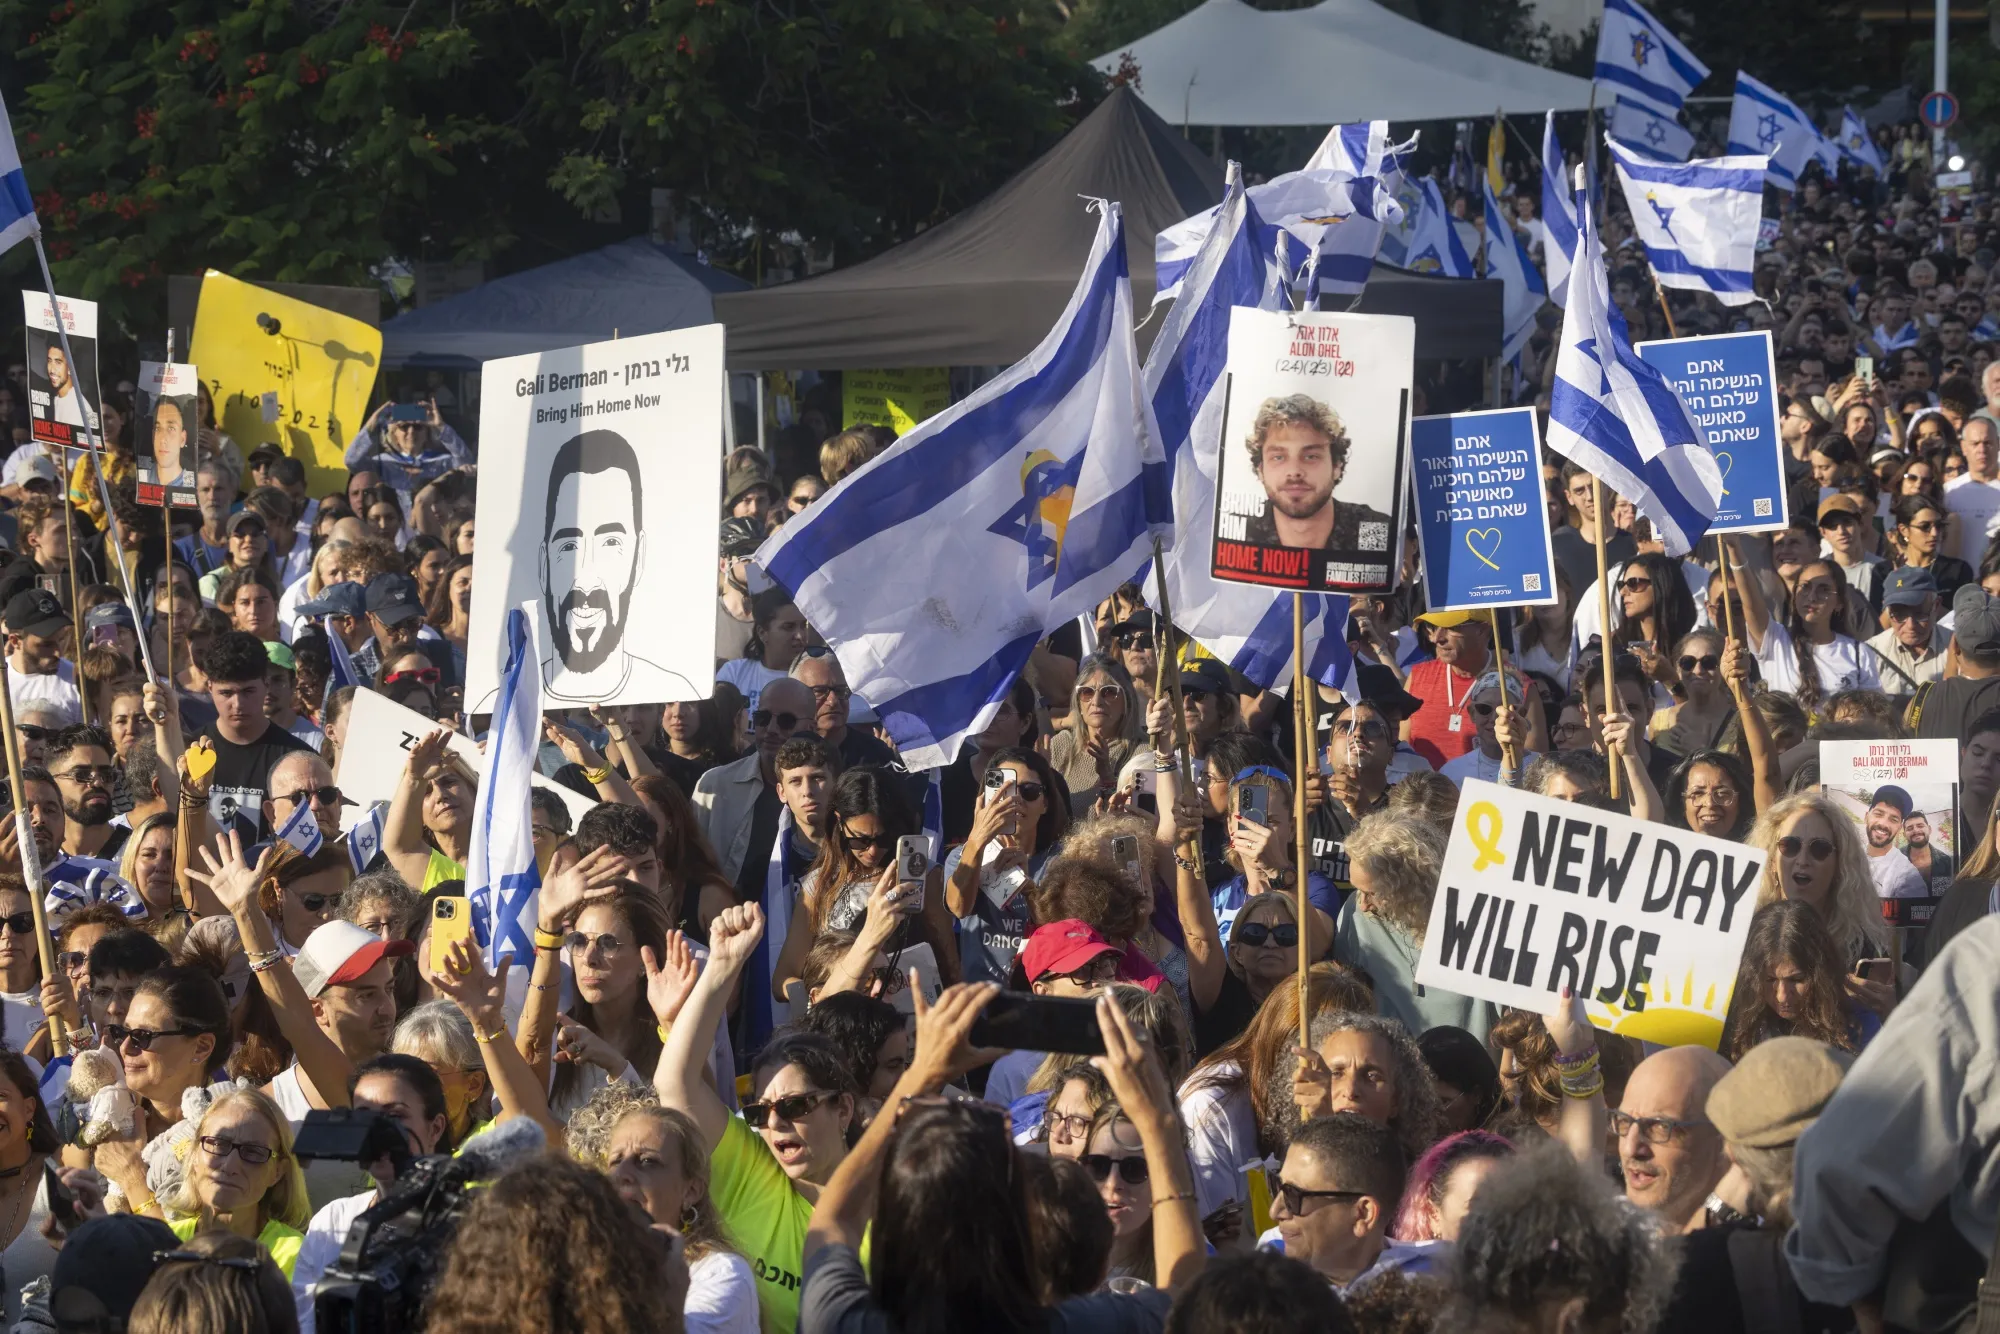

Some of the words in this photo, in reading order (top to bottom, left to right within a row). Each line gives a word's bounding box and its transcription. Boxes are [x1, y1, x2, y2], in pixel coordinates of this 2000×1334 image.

[1318, 326, 1339, 342] אלון
[1289, 342, 1315, 357] ALON
[1318, 343, 1342, 359] OHEL
[665, 353, 690, 373] גלי
[1687, 359, 1724, 374] אתם
[624, 360, 660, 386] ברמן
[516, 375, 544, 397] Gali
[549, 368, 607, 392] Berman
[1700, 374, 1762, 391] הנשימה
[31, 389, 50, 406] BRING
[1710, 391, 1759, 408] שלהם
[536, 408, 567, 424] Bring
[570, 403, 594, 418] Him
[597, 398, 631, 415] Home
[634, 393, 661, 408] Now
[1693, 410, 1745, 426] מאושר
[34, 419, 52, 435] HOME
[52, 423, 71, 439] NOW!
[1709, 427, 1759, 444] שאתם
[1455, 435, 1491, 450] אתם
[1422, 455, 1463, 470] והאור
[1468, 449, 1528, 467] הנשימה
[1429, 472, 1474, 490] חיכינו,
[1478, 466, 1525, 484] שלהם
[1445, 486, 1513, 504] מאושרים
[1220, 492, 1266, 517] BRING
[1477, 503, 1527, 519] שאתם
[1436, 508, 1473, 523] בבית
[1218, 511, 1247, 541] HIM
[1216, 541, 1259, 571] HOME
[1262, 548, 1310, 577] NOW!
[1326, 561, 1354, 571] HOSTAGES
[1354, 563, 1365, 572] AND
[1326, 570, 1359, 584] FAMILIES
[1360, 572, 1387, 584] FORUM
[1182, 662, 1202, 673] M
[1869, 745, 1885, 756] ברמן
[1853, 756, 1868, 767] GALI
[1870, 757, 1884, 767] AND
[1886, 757, 1897, 766] ZIV
[1899, 756, 1928, 767] BERMAN
[1873, 769, 1892, 779] (27)
[216, 784, 223, 792] is
[237, 785, 264, 795] dream
[1512, 810, 1643, 903] NEW
[1641, 838, 1760, 933] DAY
[1911, 911, 1933, 920] FAMILIE
[1002, 918, 1023, 932] WE
[983, 932, 1021, 949] DANC
[1439, 886, 1539, 988] WILL
[1547, 911, 1661, 1013] RISE
